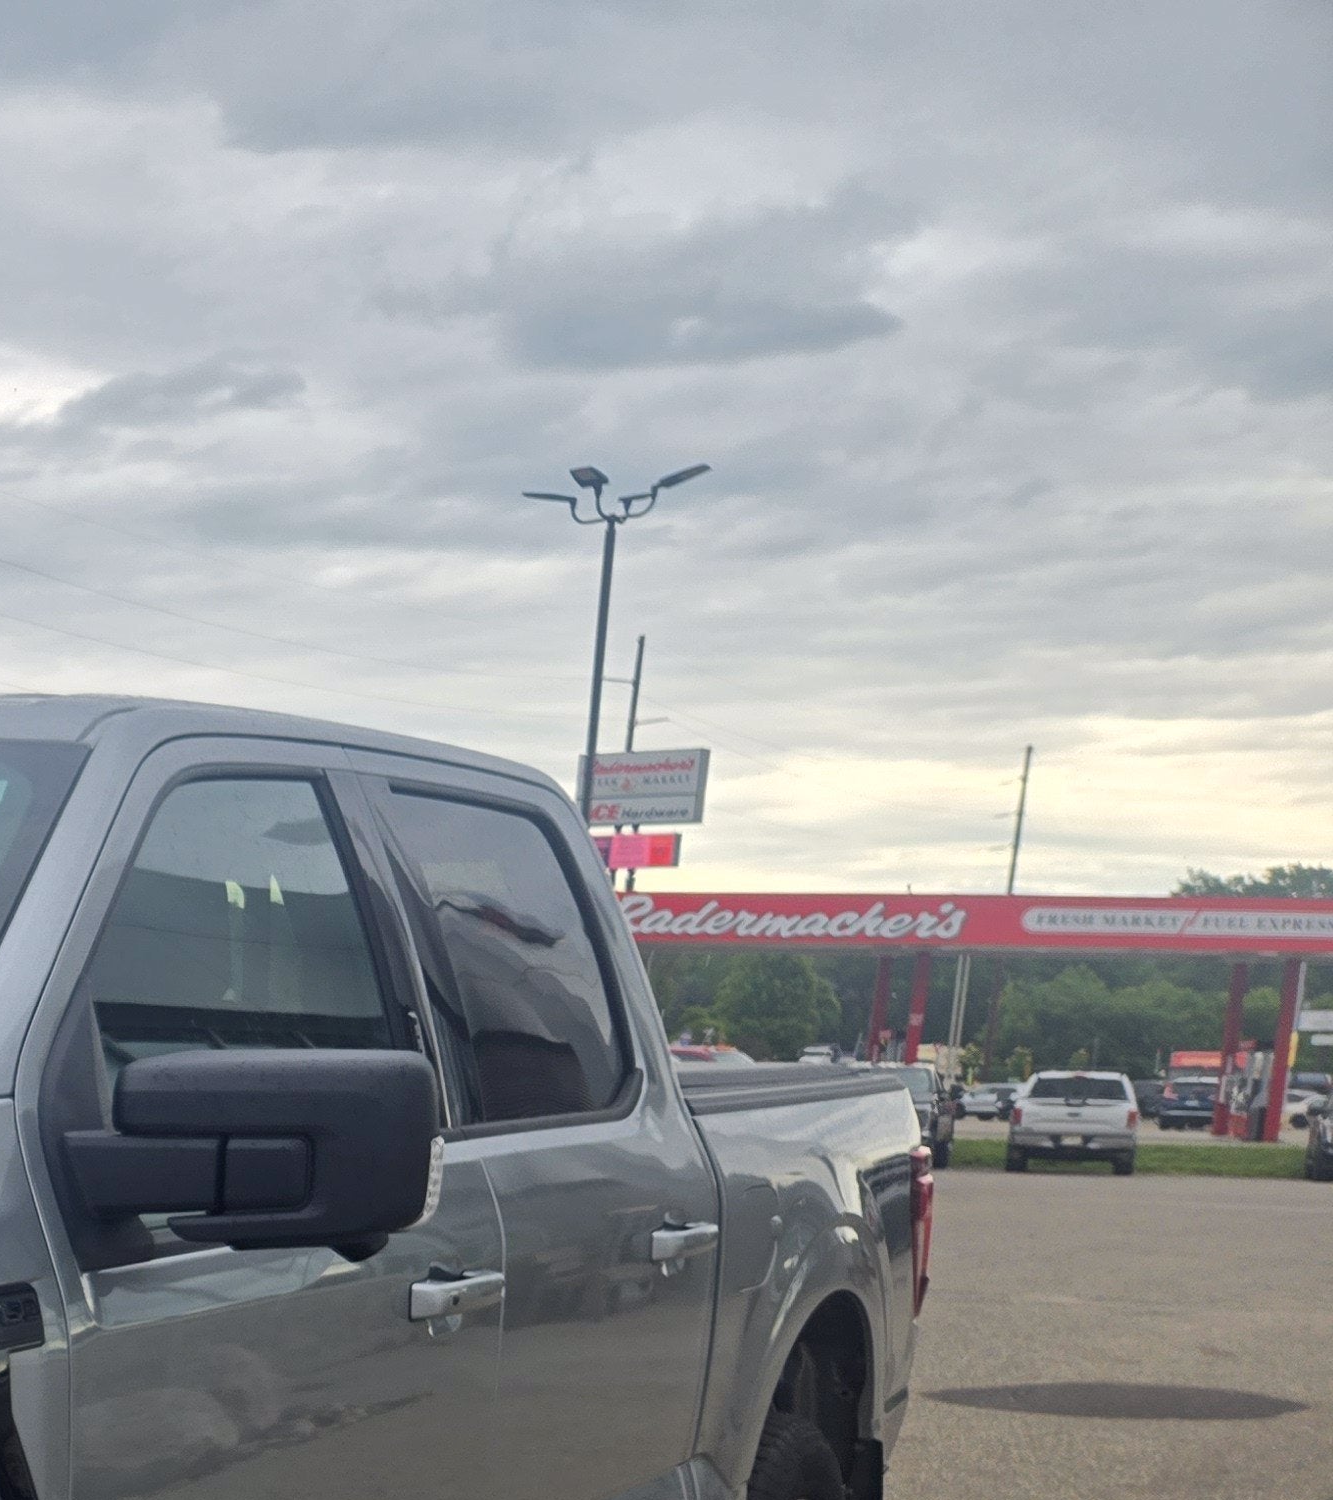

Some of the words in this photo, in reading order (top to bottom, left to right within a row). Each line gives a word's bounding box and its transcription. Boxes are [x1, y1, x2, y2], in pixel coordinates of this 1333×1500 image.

[620, 807, 688, 819] Hardware
[621, 895, 966, 938] Radermacher's
[1036, 912, 1094, 926] FRESH
[1103, 914, 1180, 928] MARKET
